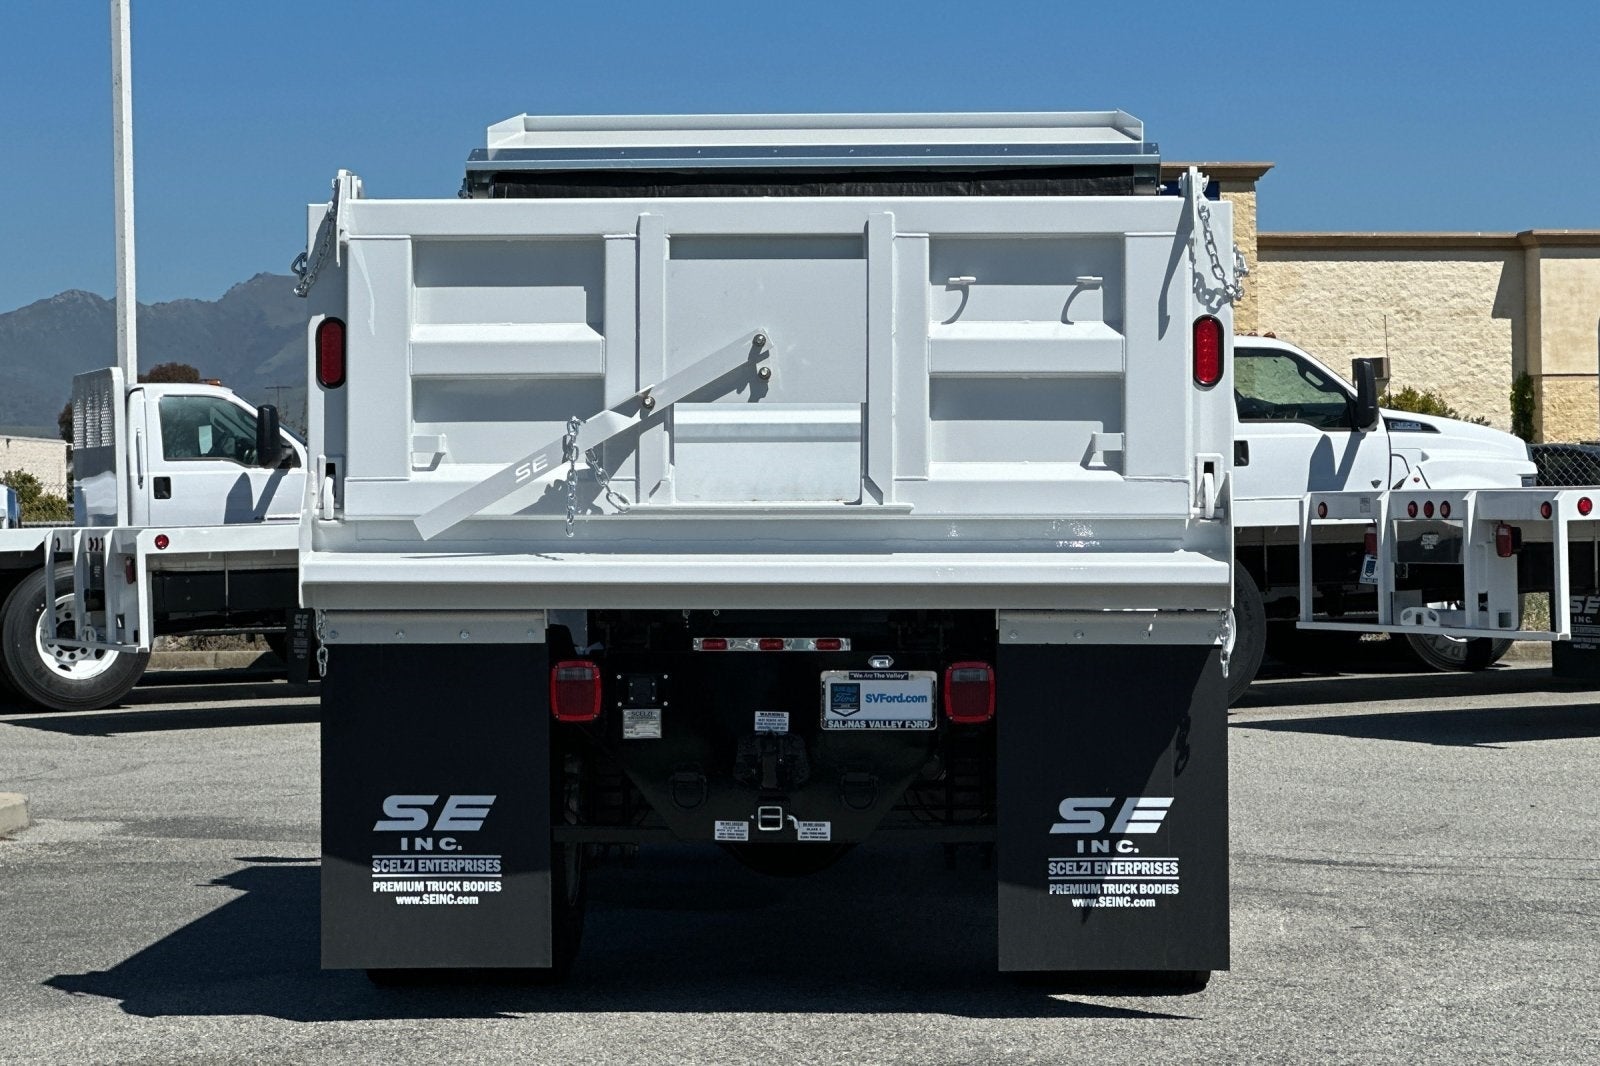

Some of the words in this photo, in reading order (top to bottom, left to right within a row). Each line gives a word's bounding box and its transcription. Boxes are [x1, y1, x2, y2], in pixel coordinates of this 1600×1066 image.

[515, 453, 548, 483] SE
[865, 693, 928, 703] SVFord.com
[869, 720, 903, 729] VALLEY
[905, 720, 930, 729] FORD
[372, 794, 497, 831] SE
[1049, 797, 1175, 834] SE
[400, 837, 463, 851] INC.
[1077, 840, 1140, 853] INC.
[372, 859, 415, 873] SCELZI
[418, 859, 502, 873] ENTERPRISES
[1048, 862, 1091, 875] SCELZI
[1094, 862, 1179, 875] ENTERPRISES
[372, 881, 424, 892] PREMIUM
[426, 881, 461, 892] TRUCK
[463, 881, 502, 892] BODIES
[1049, 883, 1100, 894] PREMIUM
[1102, 883, 1138, 894] TRUCK
[1139, 883, 1179, 894] BODIES
[396, 894, 479, 905] www.SEINC.com
[1072, 896, 1156, 908] www.SEINC.com
